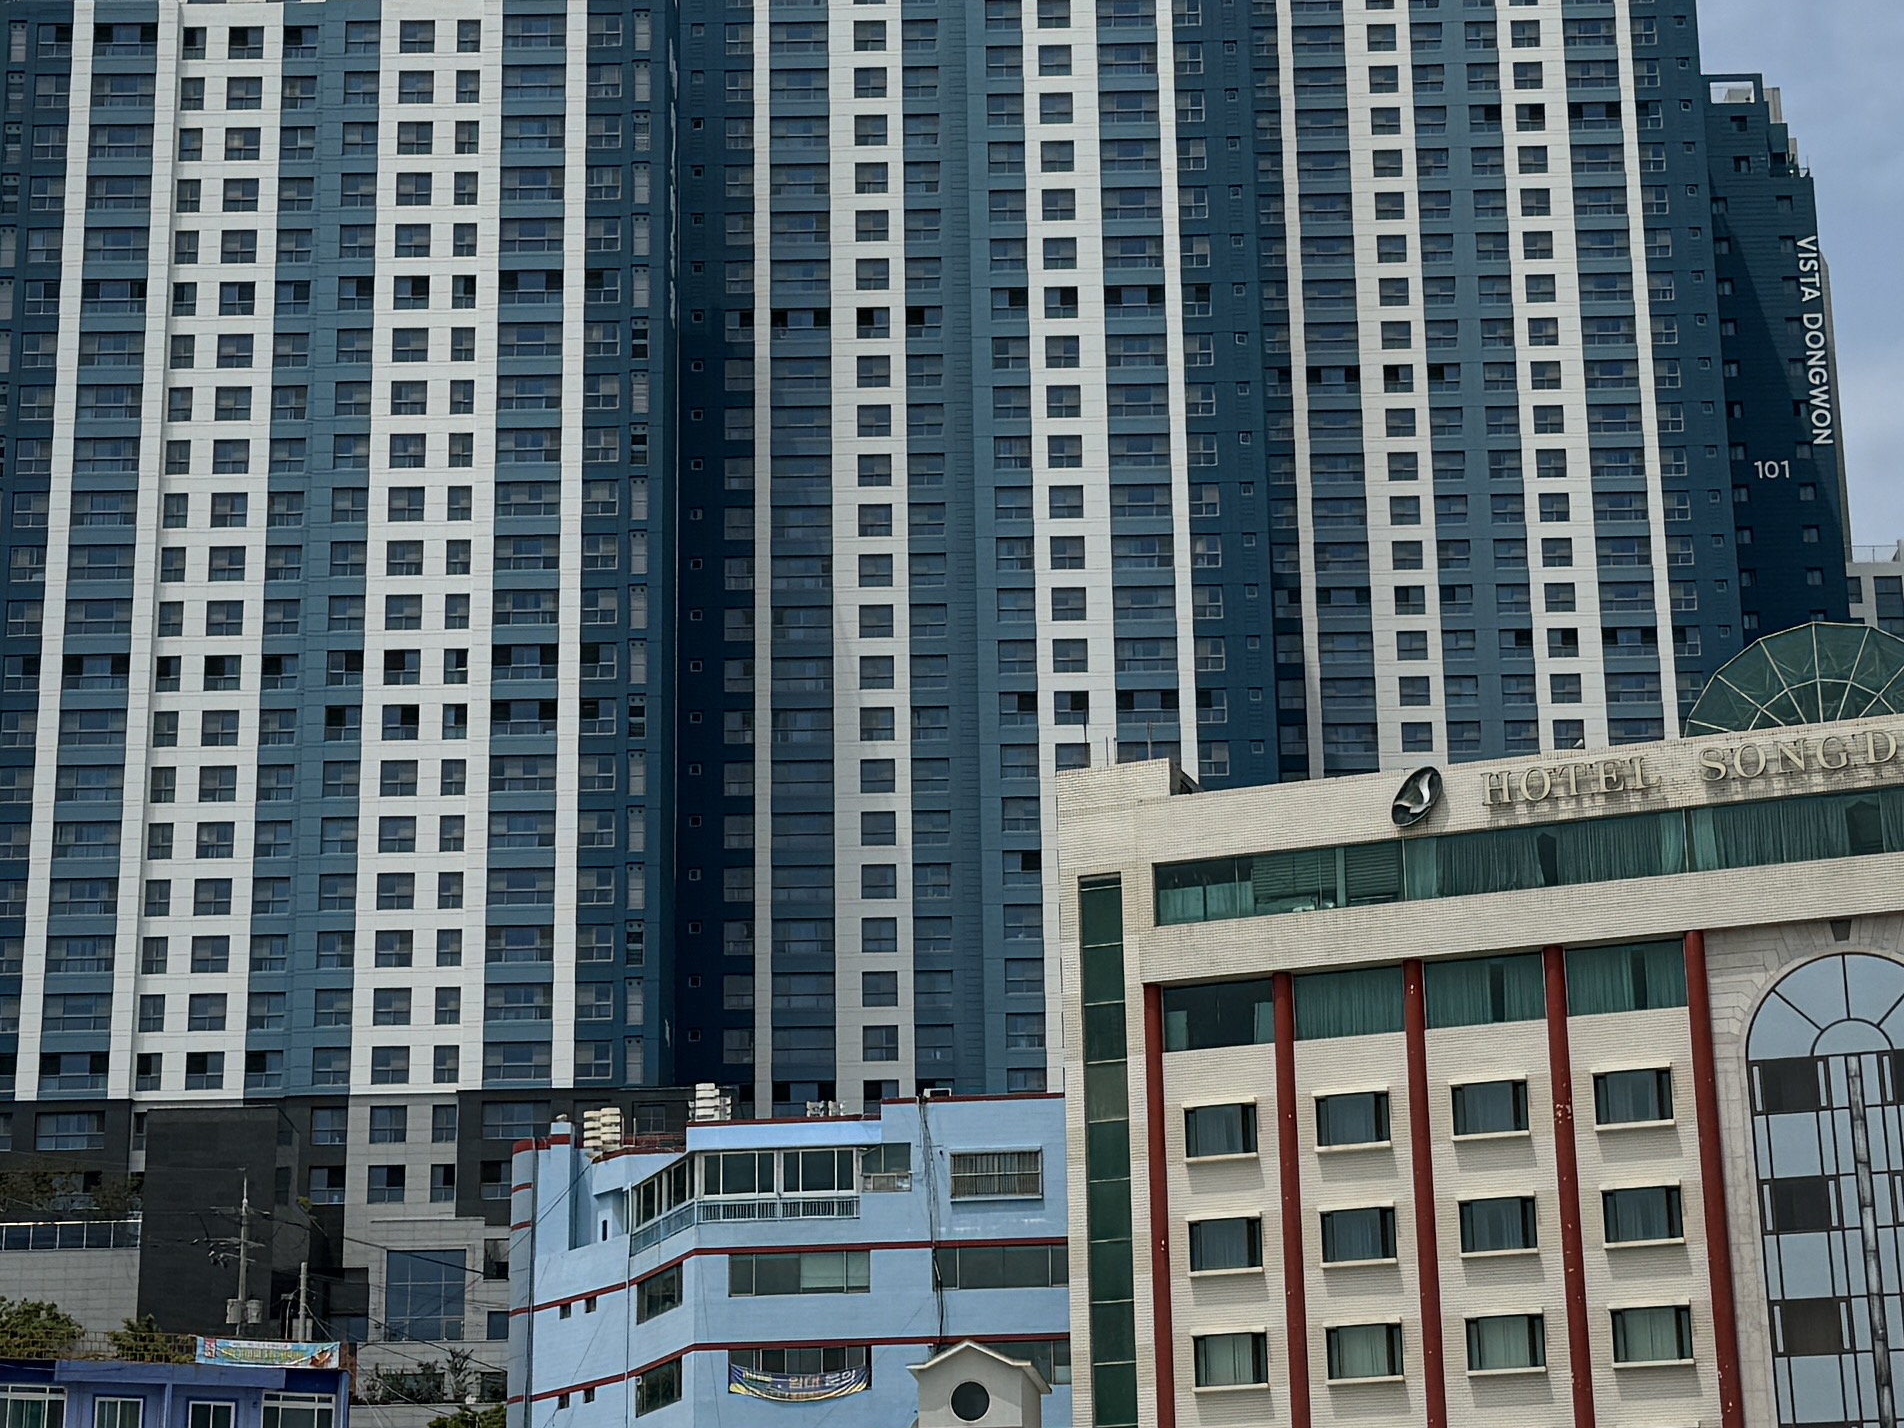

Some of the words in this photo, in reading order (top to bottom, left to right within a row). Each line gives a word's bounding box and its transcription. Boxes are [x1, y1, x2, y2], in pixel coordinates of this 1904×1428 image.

[1797, 235, 1821, 302] VISTA
[1803, 313, 1834, 445] DONGWON
[1754, 460, 1790, 479] 101
[1482, 753, 1661, 807] HOTEL
